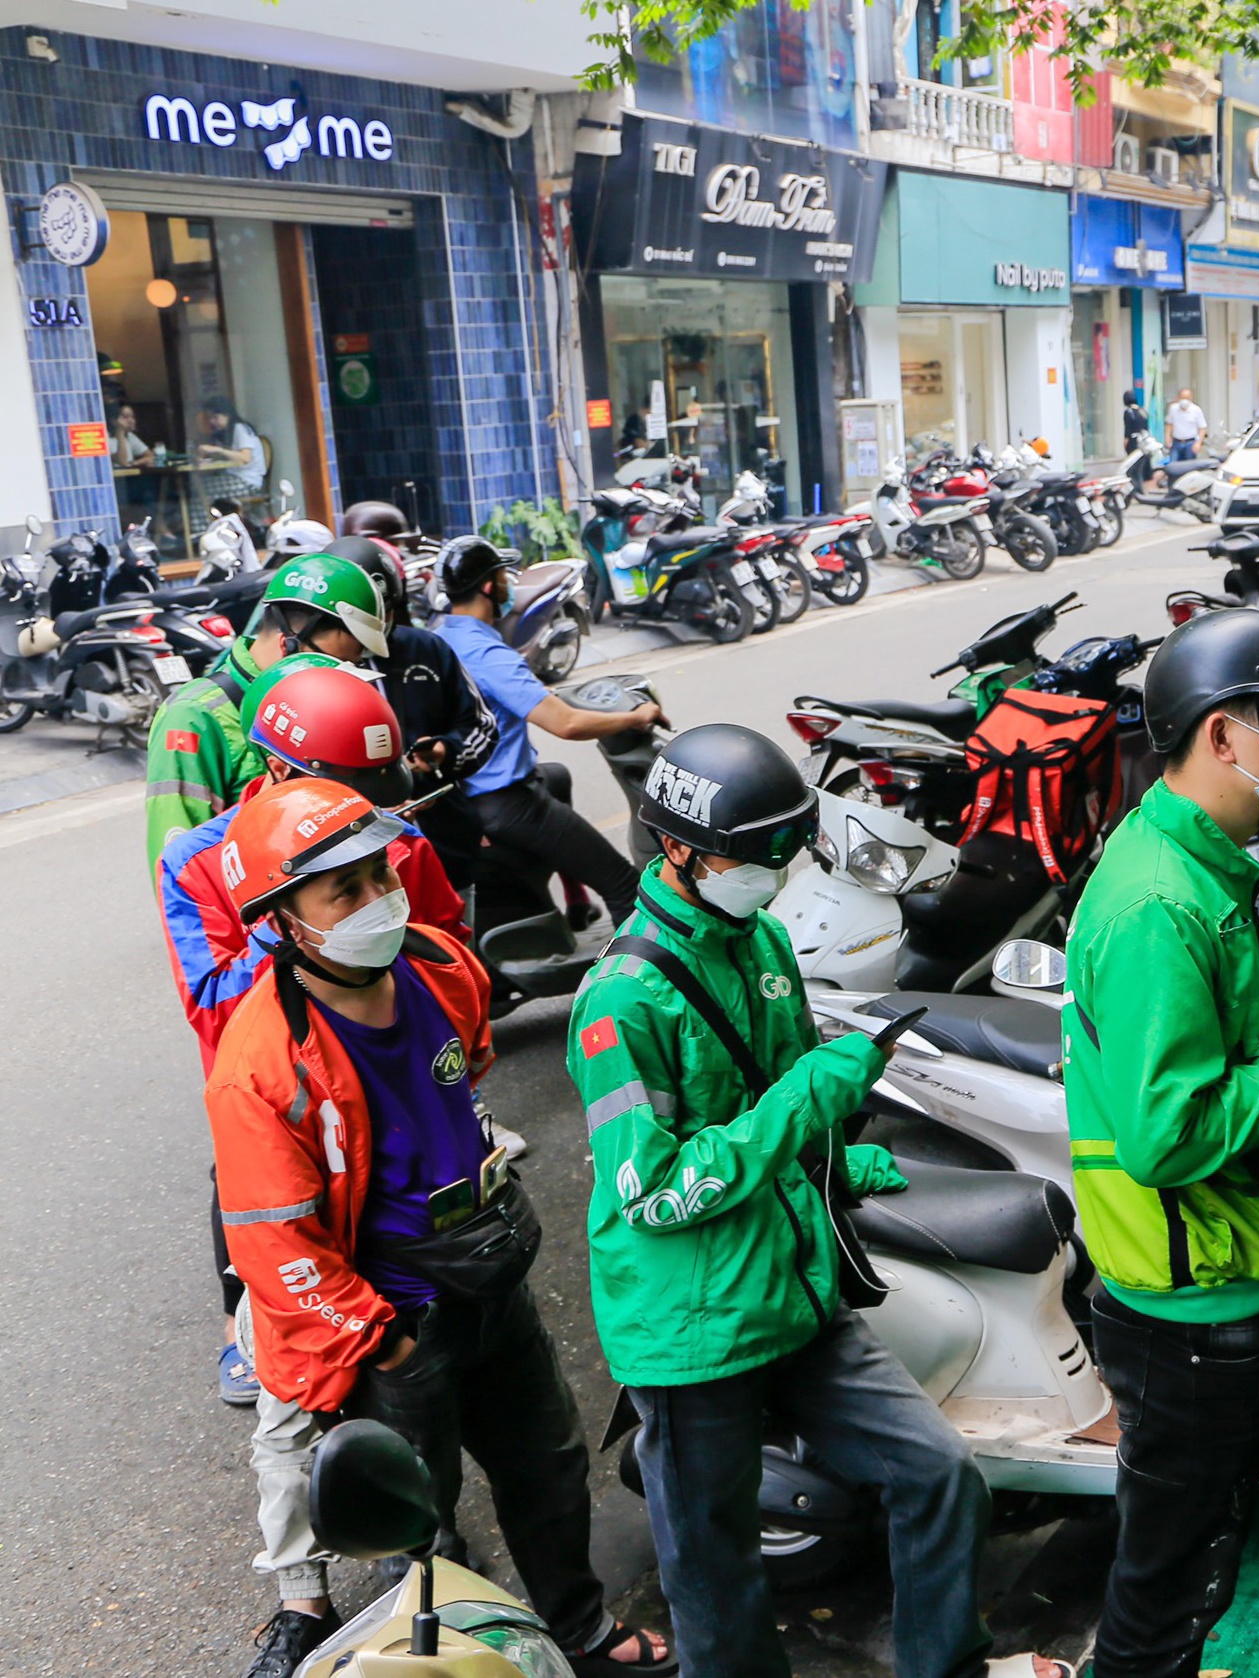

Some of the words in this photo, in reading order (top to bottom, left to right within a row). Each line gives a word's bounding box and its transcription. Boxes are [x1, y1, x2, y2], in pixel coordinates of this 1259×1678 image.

[145, 93, 237, 148] me
[317, 114, 393, 161] me
[996, 263, 1022, 288] Nail
[1022, 265, 1038, 292] by
[29, 299, 83, 328] 51A
[283, 571, 329, 595] Grab
[677, 768, 700, 786] WILL
